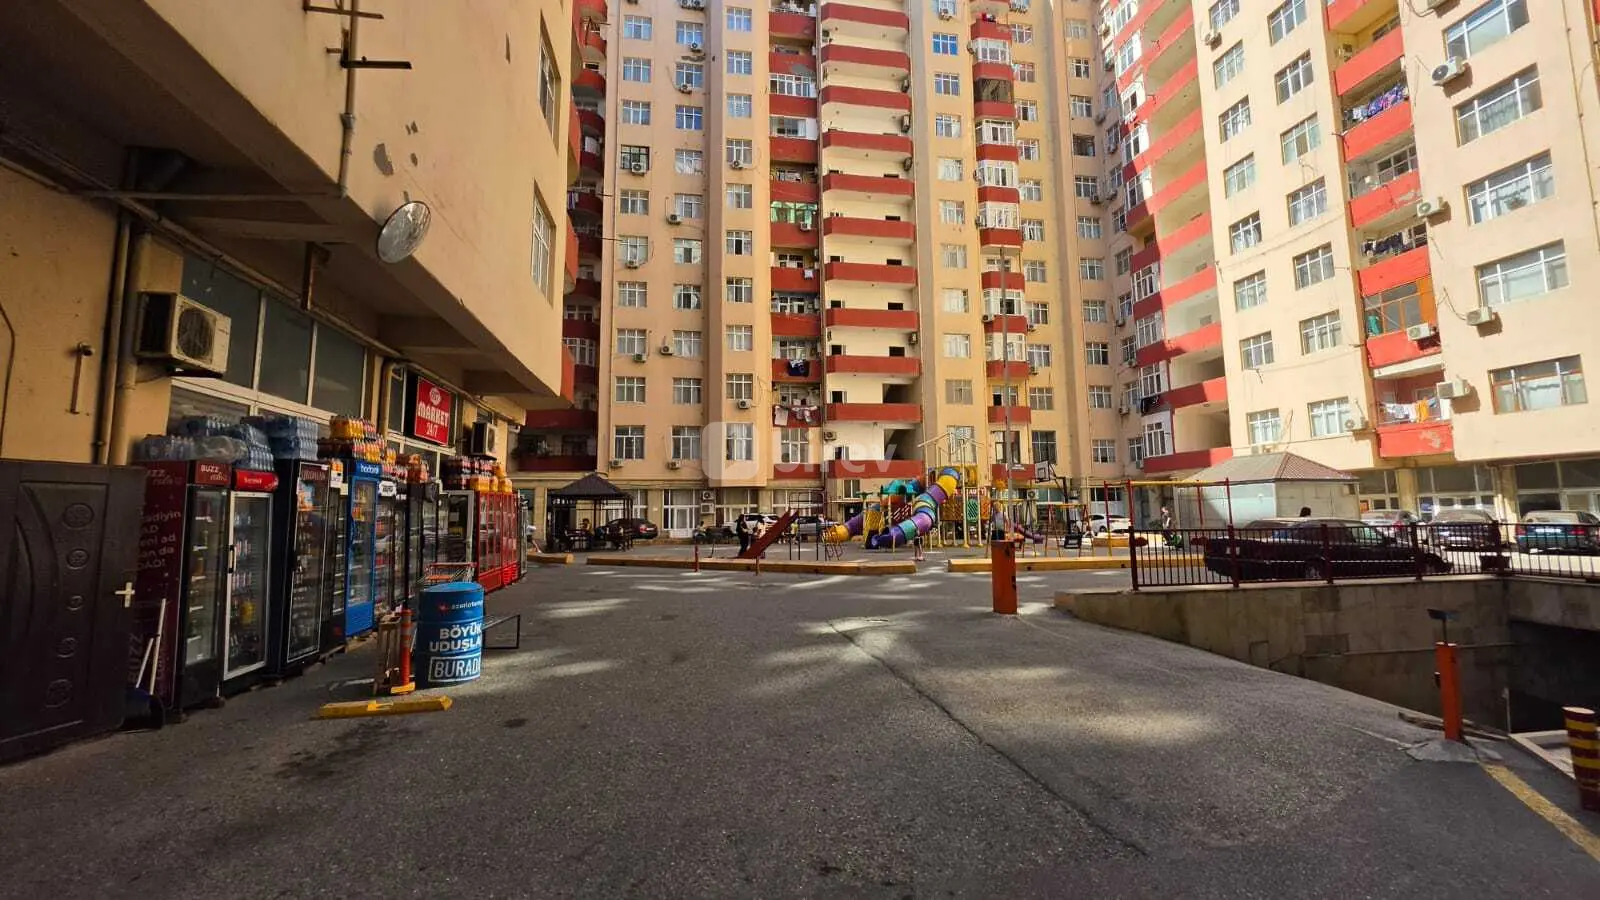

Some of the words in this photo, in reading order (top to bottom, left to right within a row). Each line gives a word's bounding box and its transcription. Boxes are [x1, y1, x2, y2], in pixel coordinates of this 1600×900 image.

[417, 401, 449, 428] MARKET
[426, 422, 438, 438] 24/7
[200, 464, 220, 473] BUZZ
[429, 638, 482, 652] UDUŞLA
[434, 658, 480, 678] BURAD
